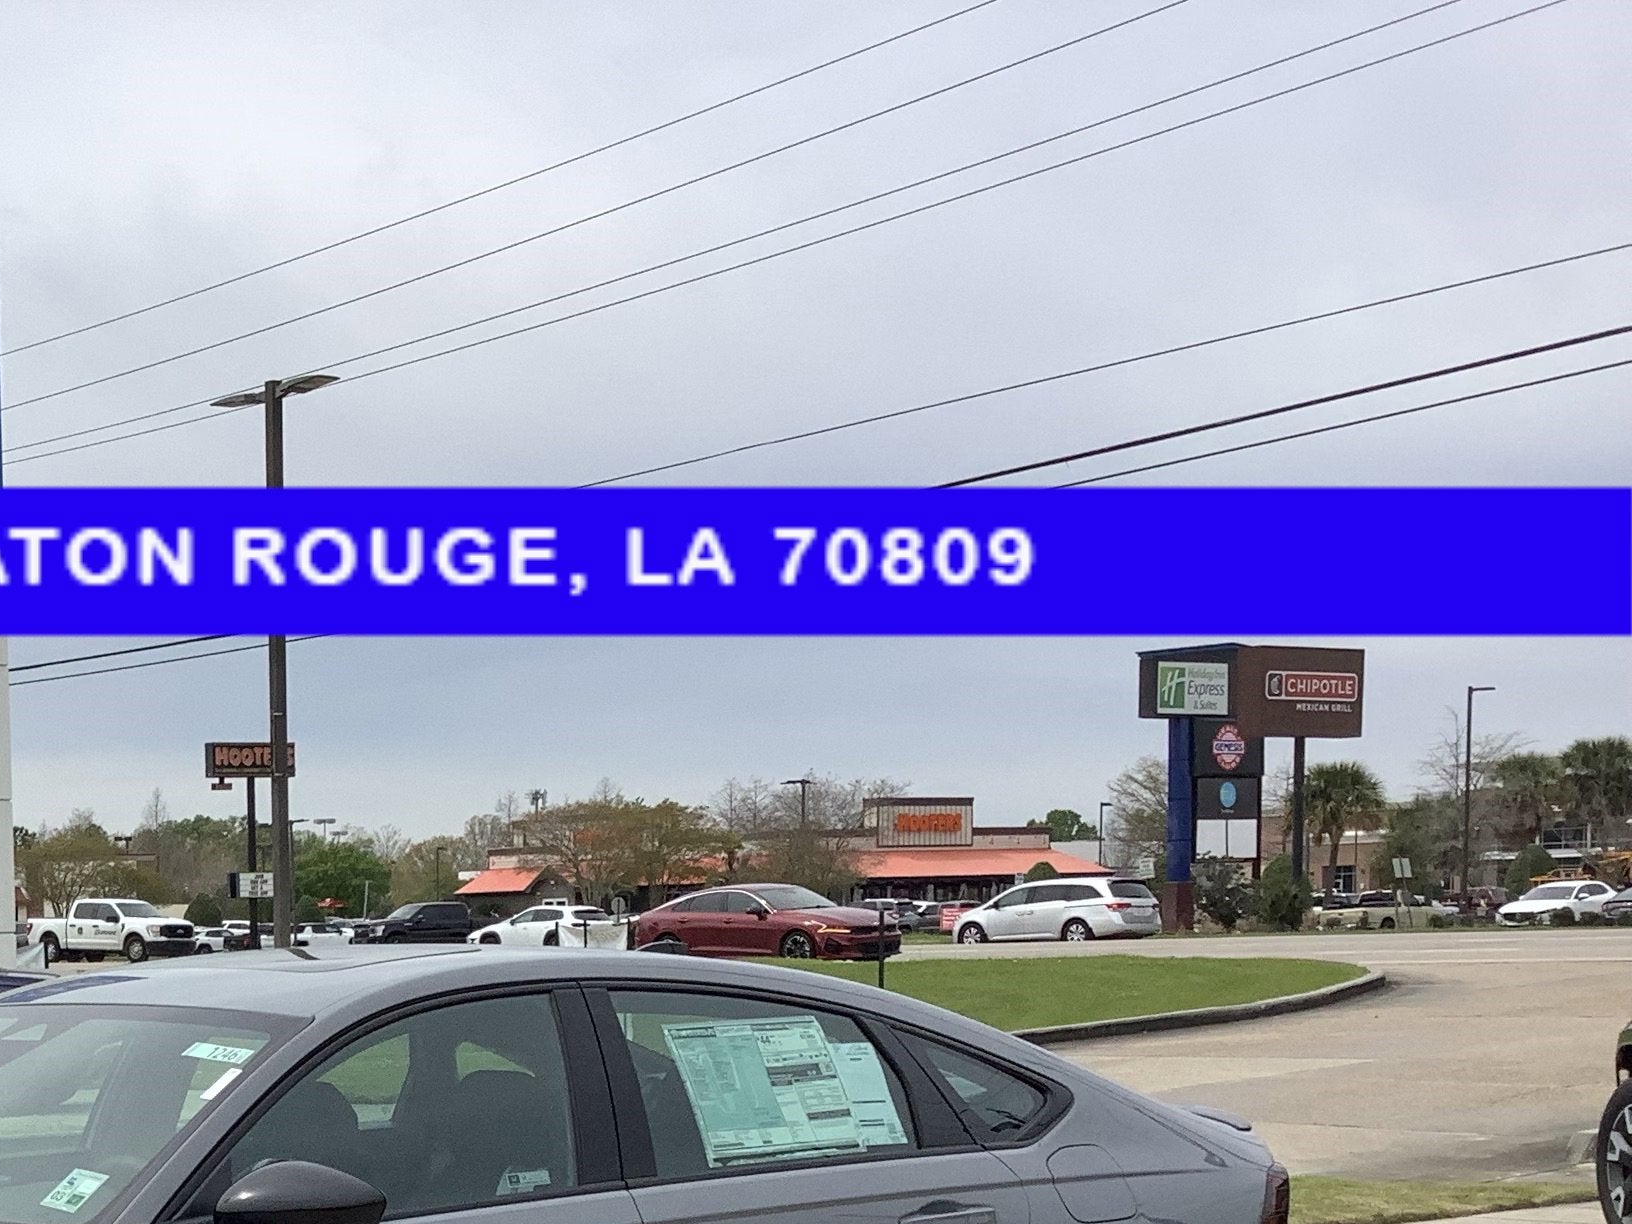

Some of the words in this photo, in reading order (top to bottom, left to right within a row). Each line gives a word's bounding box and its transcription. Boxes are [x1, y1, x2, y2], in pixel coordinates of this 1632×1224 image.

[1187, 680, 1225, 699] Express
[1287, 679, 1354, 695] CHIPOTLE
[1296, 703, 1330, 712] MEXICAN
[1331, 704, 1353, 713] GRILL
[214, 746, 295, 767] HOOTES
